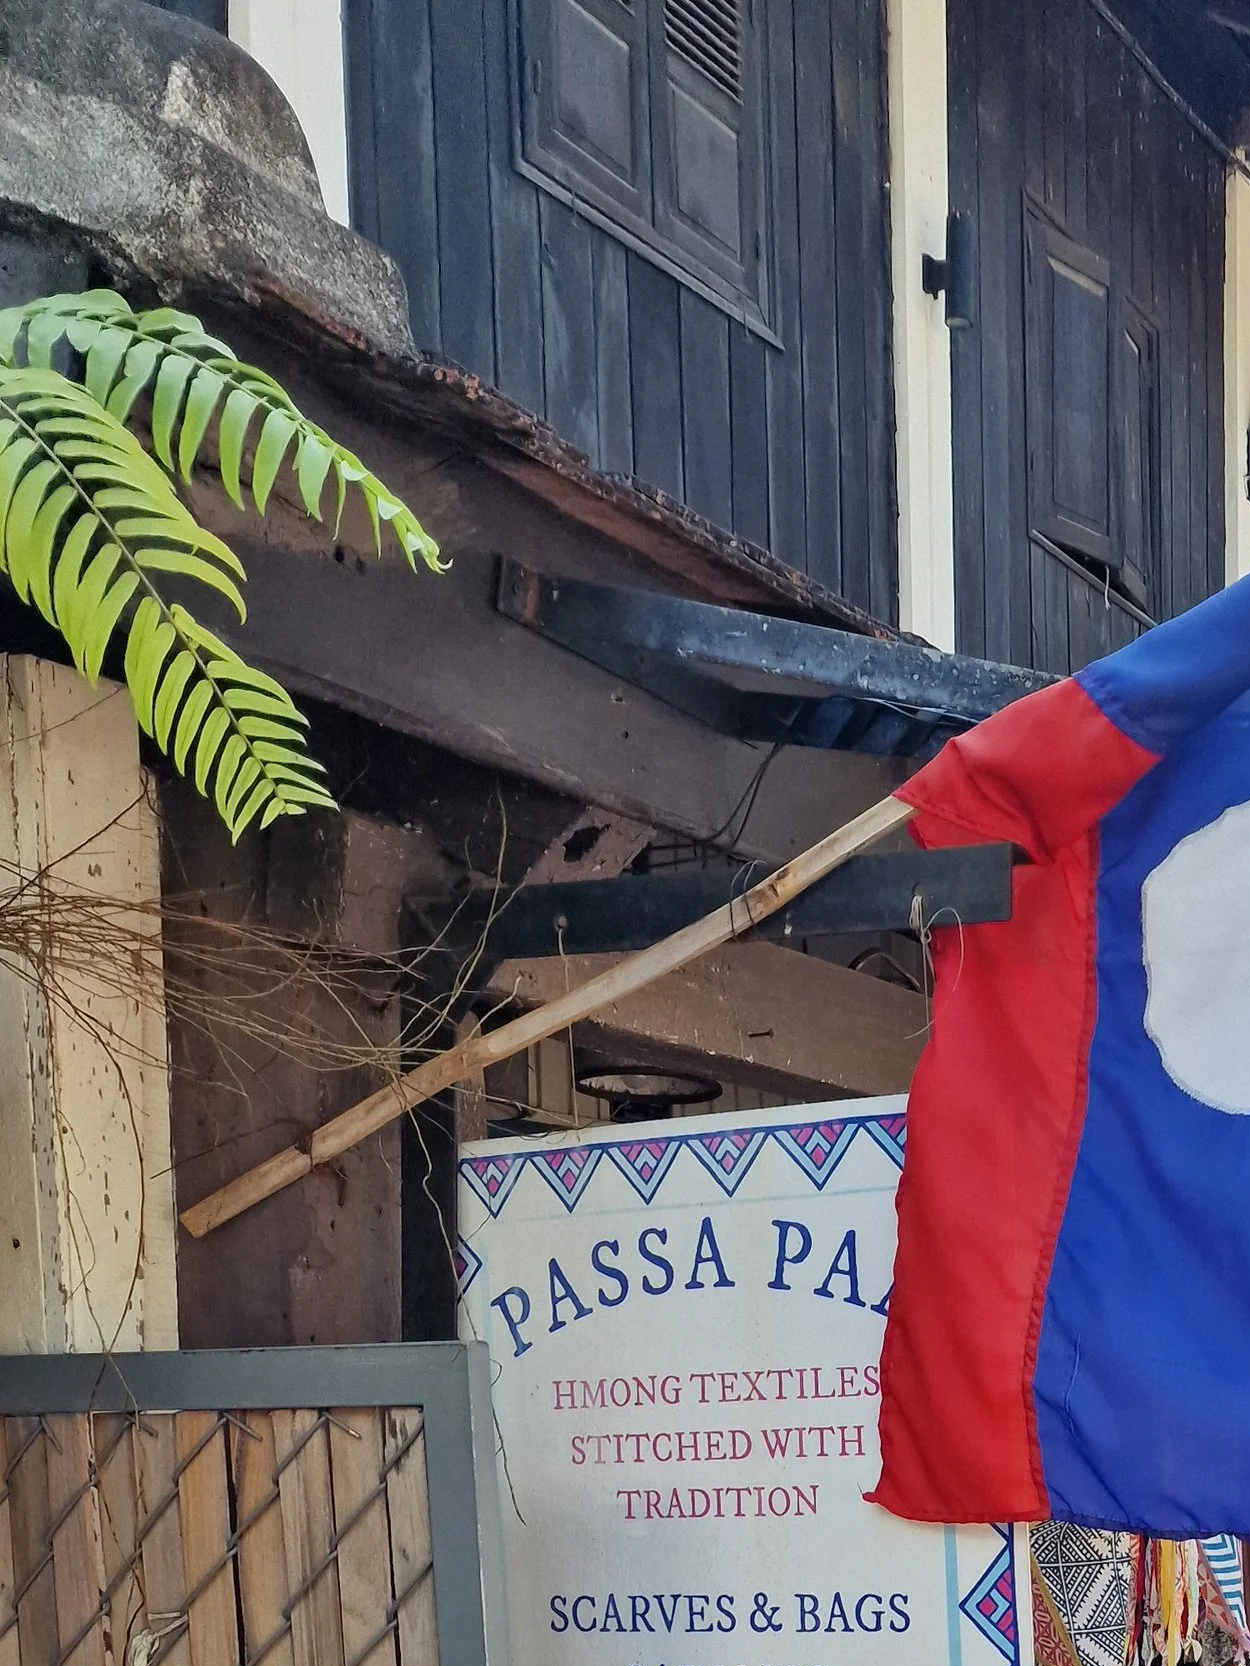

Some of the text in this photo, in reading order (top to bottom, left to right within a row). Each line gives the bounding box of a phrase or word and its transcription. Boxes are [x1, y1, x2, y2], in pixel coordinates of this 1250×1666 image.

[490, 1216, 736, 1358] PASSA
[552, 1365, 881, 1410] HMONG TEXTILES
[571, 1424, 866, 1465] STITCHED WITH
[616, 1484, 820, 1521] TRADITION
[549, 1591, 912, 1634] SCARVES & BAGS
